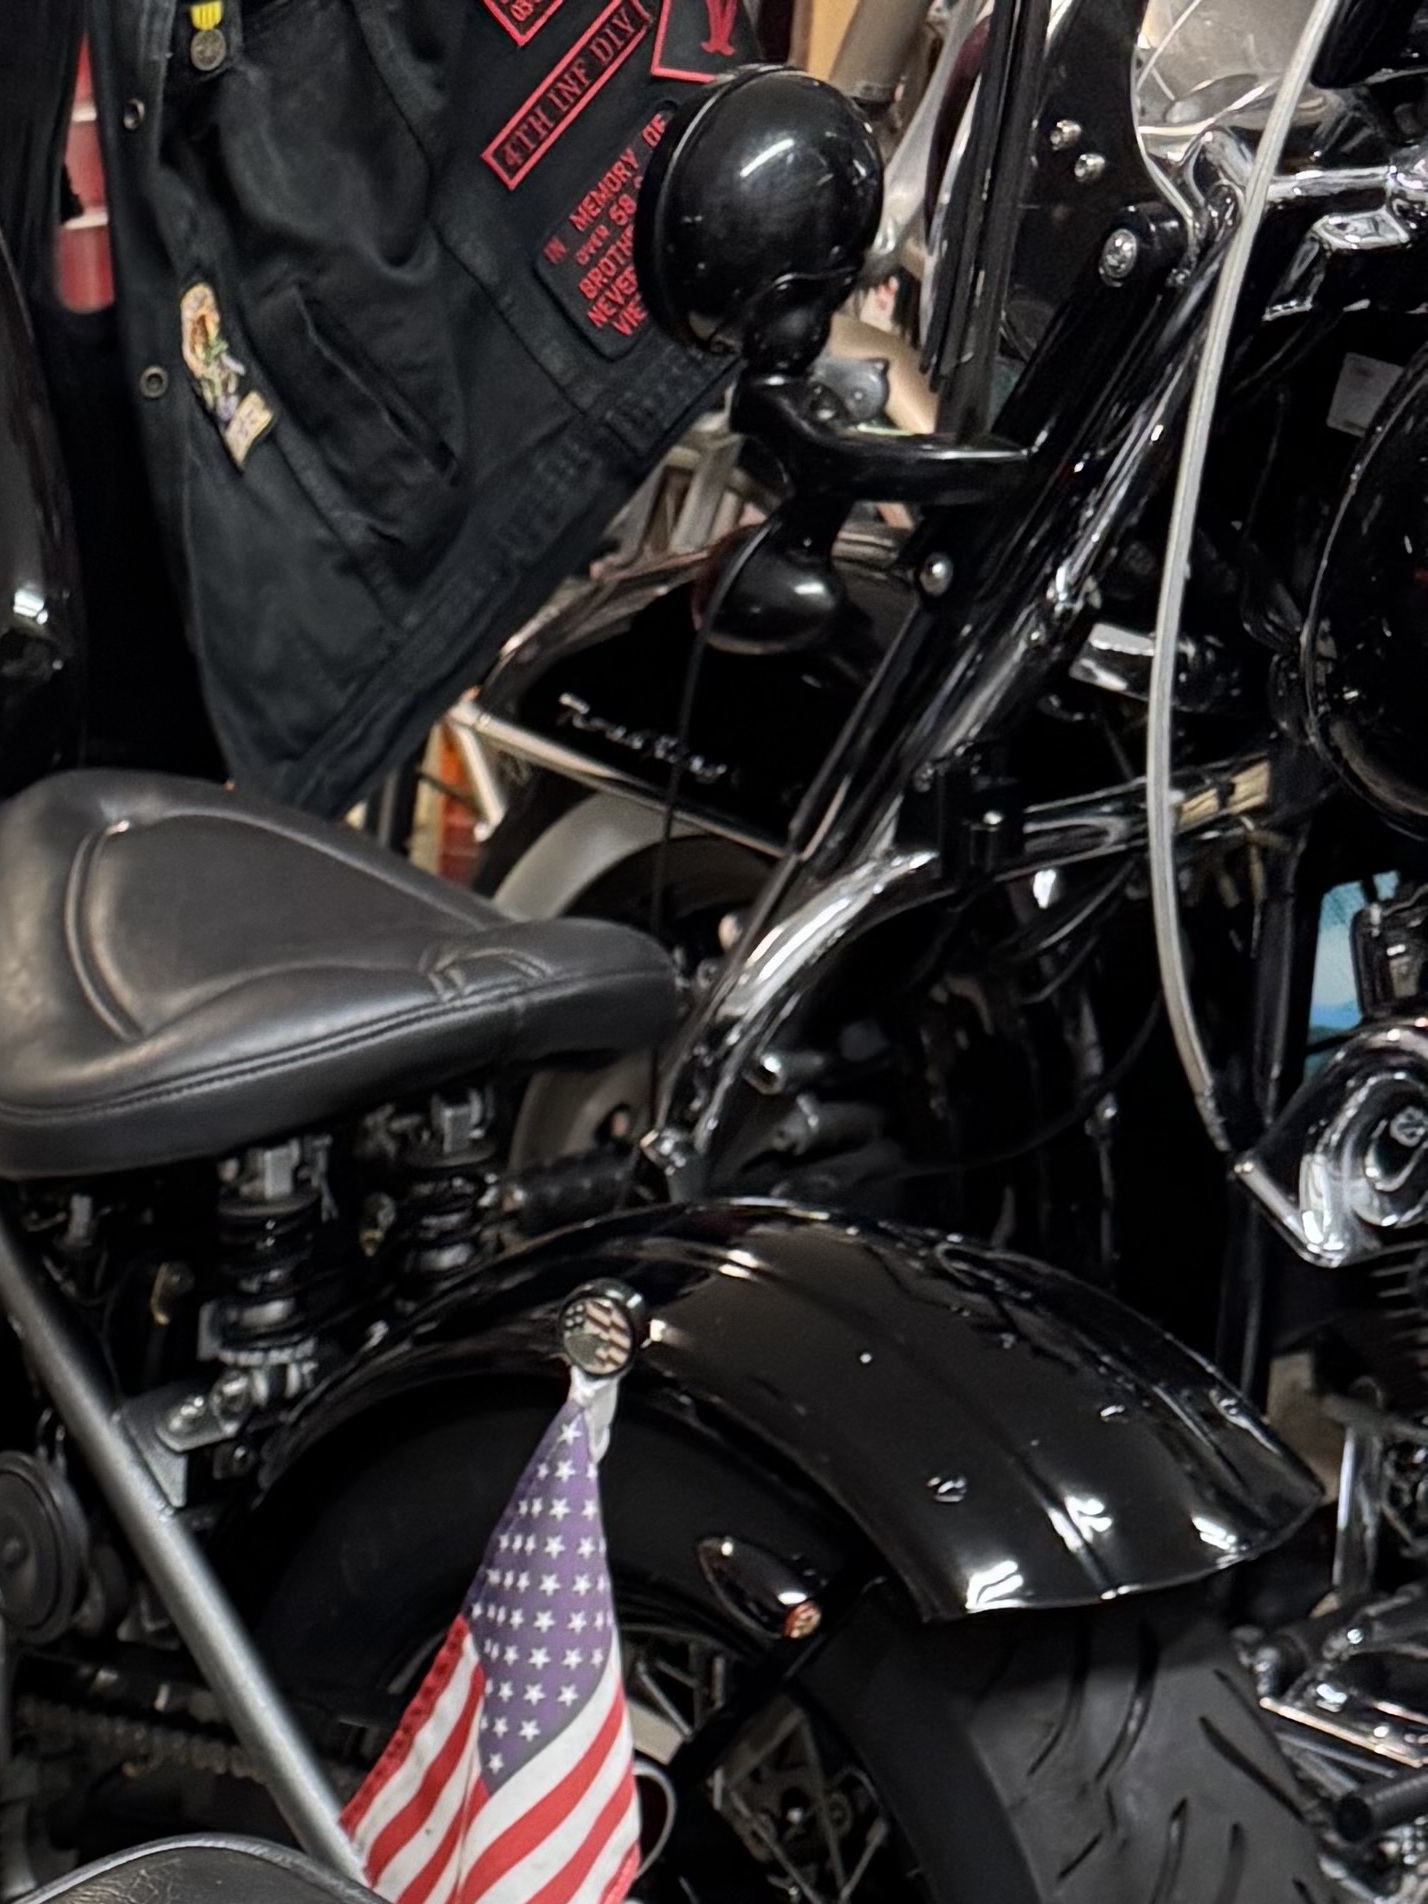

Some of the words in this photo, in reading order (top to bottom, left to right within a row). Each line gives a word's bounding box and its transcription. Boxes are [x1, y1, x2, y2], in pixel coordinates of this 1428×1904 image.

[502, 111, 554, 168] 4TH
[546, 57, 594, 114] INF
[588, 5, 636, 66] DIV
[569, 147, 639, 232] MEMORY
[642, 112, 667, 148] OF
[573, 223, 610, 266] OVER
